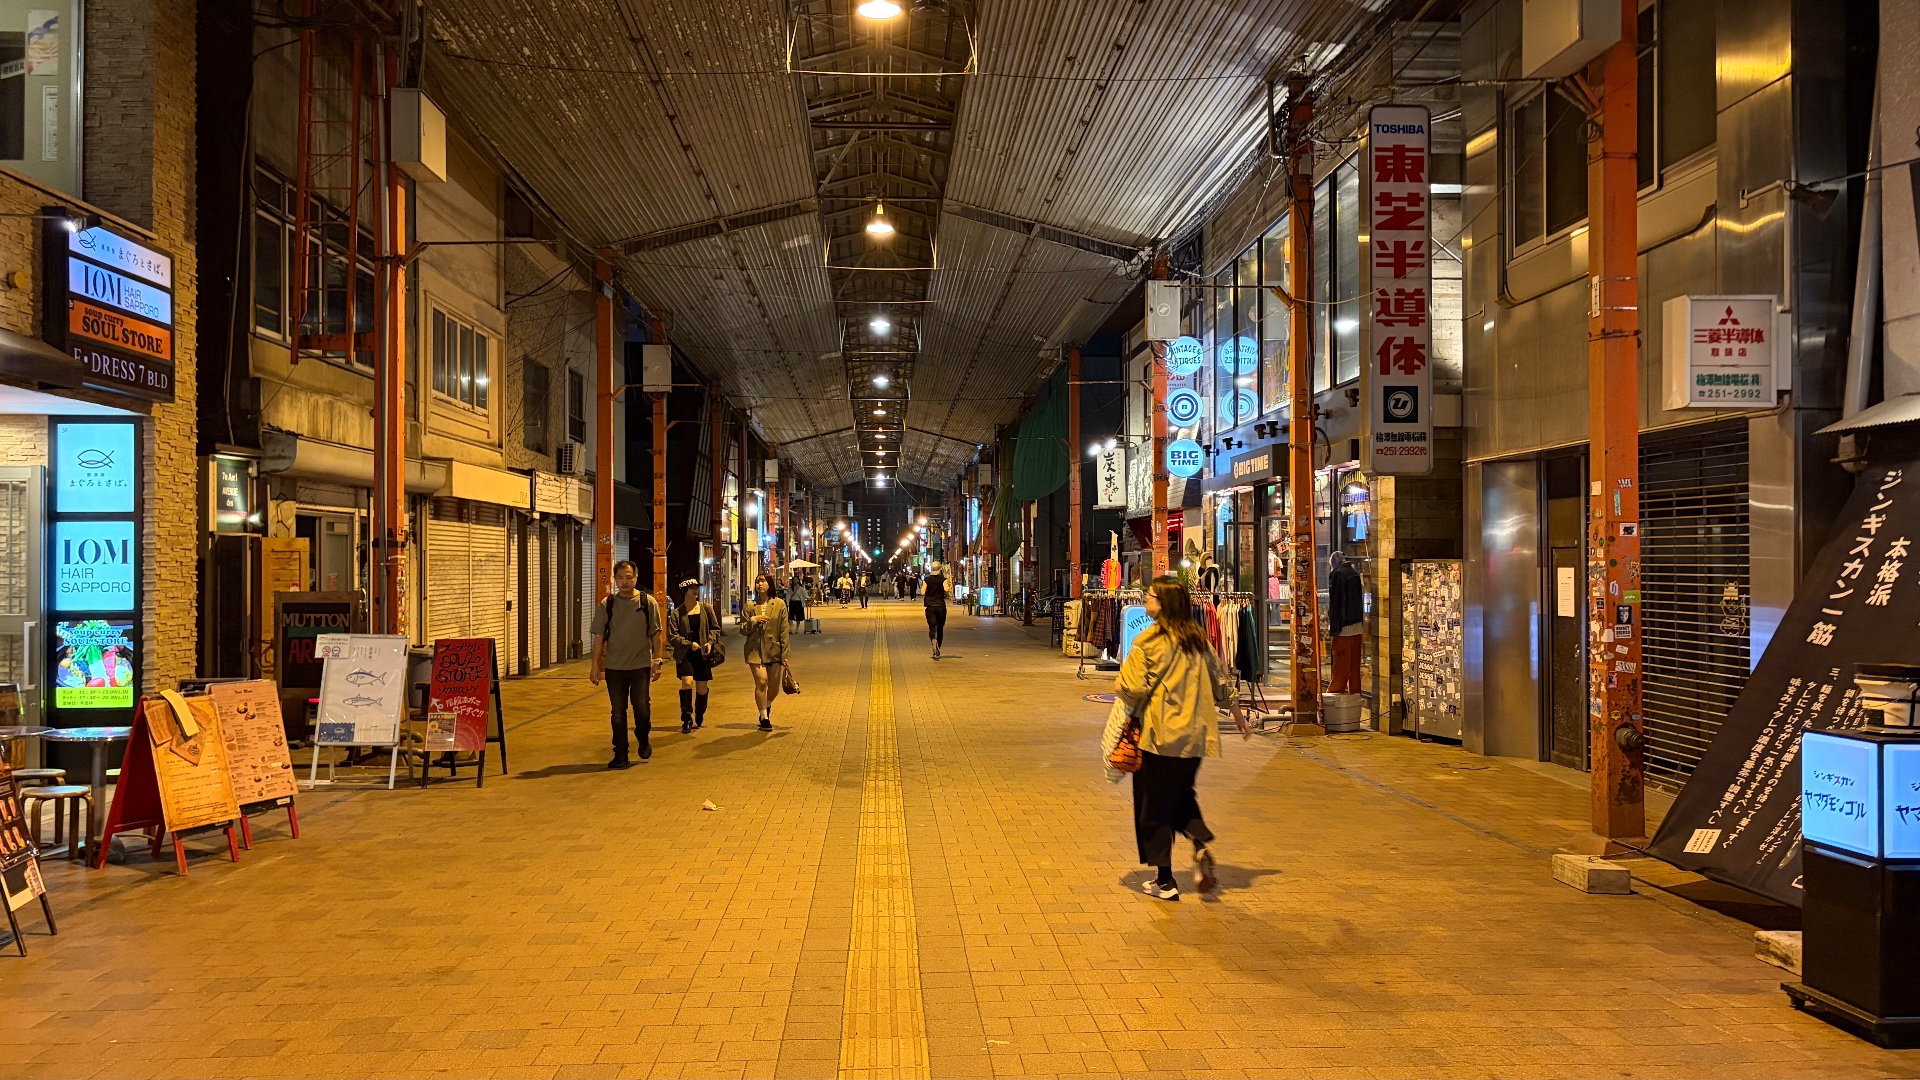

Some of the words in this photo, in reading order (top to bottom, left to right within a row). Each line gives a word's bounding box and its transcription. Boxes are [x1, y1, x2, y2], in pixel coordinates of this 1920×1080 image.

[1374, 124, 1425, 134] TOSHIBA
[1374, 144, 1425, 376] 東芝半導体
[124, 284, 142, 301] HAIR
[124, 296, 160, 318] SAPPORO
[85, 307, 103, 320] soup
[104, 313, 125, 327] curry
[82, 315, 120, 342] SOUL
[121, 327, 163, 354] STORE
[1693, 328, 1765, 344] 三菱半導体
[1711, 347, 1747, 357] 取扱店
[138, 364, 145, 384] 7
[147, 370, 168, 389] BLD
[1707, 389, 1761, 399] 251-2992
[1170, 450, 1199, 459] BIG
[1238, 460, 1251, 476] BIG
[1250, 454, 1269, 474] TIME
[69, 479, 128, 488] まぐろとさば。
[63, 538, 130, 565] LOM
[1806, 469, 1902, 647] ジンギスカン一筋
[61, 567, 94, 579] HAIR
[1865, 536, 1912, 606] 本格派
[61, 581, 131, 593] SAPPORO
[282, 613, 350, 628] MUTTON
[64, 637, 92, 645] SOUL
[93, 637, 128, 645] STORE
[1805, 789, 1868, 822] ヤマダモンゴル
